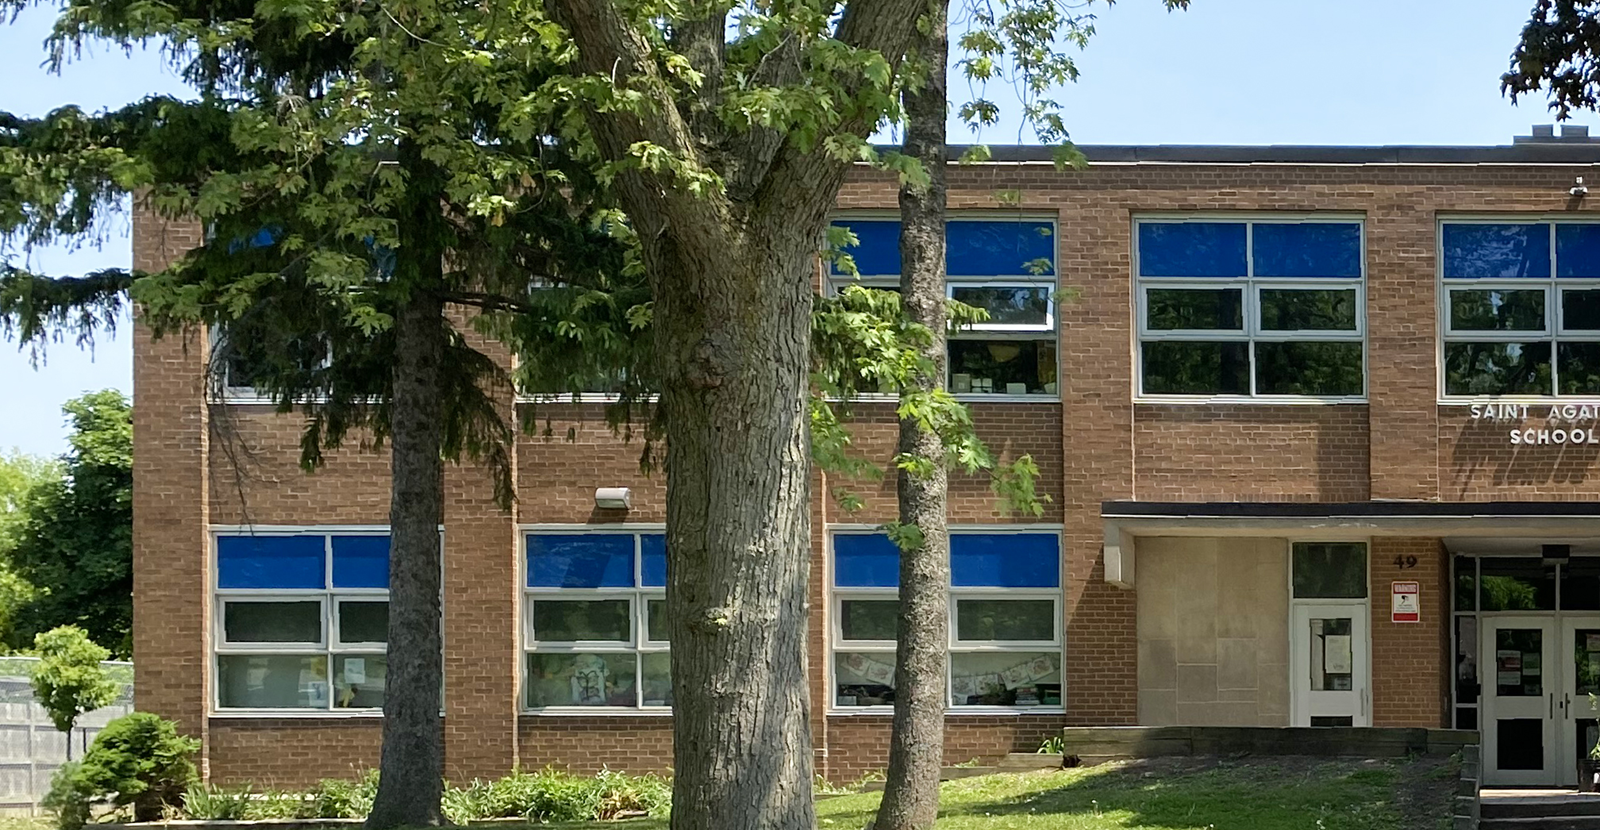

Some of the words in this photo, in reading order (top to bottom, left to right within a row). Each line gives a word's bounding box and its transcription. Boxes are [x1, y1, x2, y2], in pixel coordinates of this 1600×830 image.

[1471, 404, 1529, 419] SAINT
[1510, 429, 1599, 444] SCHOOL
[1393, 554, 1417, 569] 49
